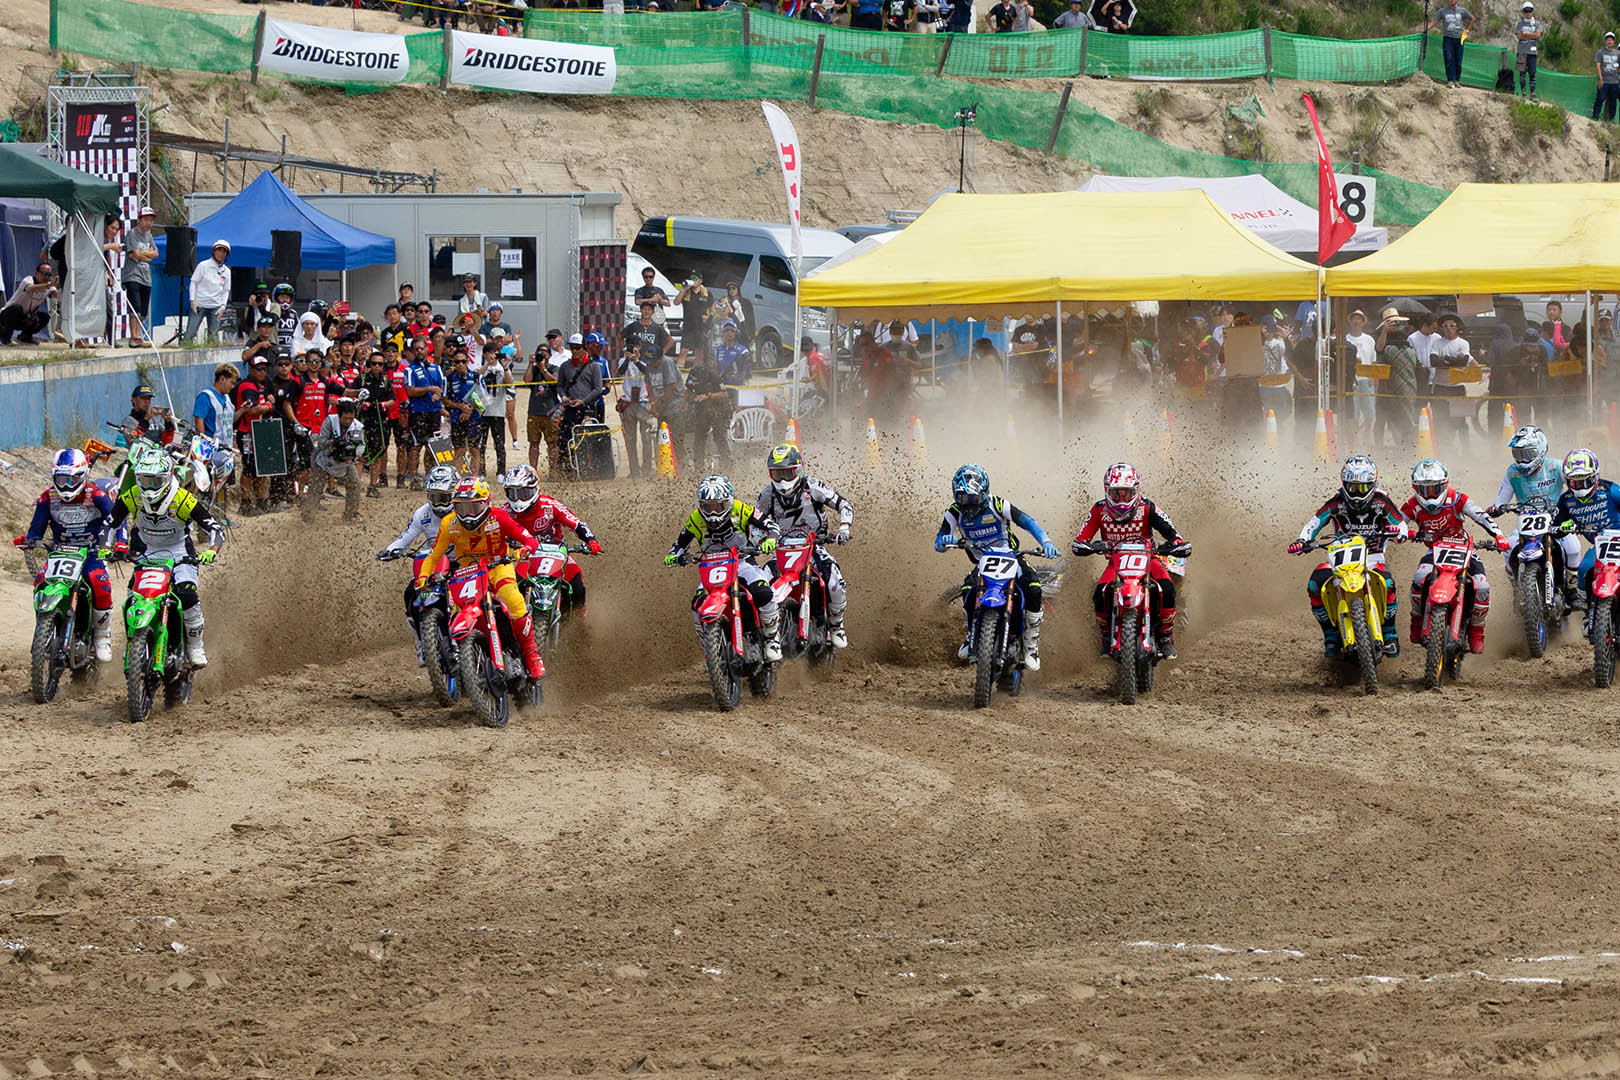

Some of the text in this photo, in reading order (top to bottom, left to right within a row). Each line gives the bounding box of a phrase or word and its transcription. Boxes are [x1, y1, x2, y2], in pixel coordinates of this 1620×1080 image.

[271, 38, 400, 69] BRIDGESTONE
[463, 48, 606, 76] BRIDGESTONE
[1340, 181, 1366, 223] 8
[661, 432, 668, 440] 6
[1536, 478, 1556, 488] THOR
[1522, 516, 1546, 531] 28
[1333, 547, 1362, 566] 11
[1436, 549, 1467, 565] 12
[1599, 541, 1620, 560] 15
[52, 560, 77, 577] 13
[537, 558, 555, 573] 8
[784, 551, 803, 569] 7
[983, 557, 1015, 574] 27
[1119, 554, 1148, 570] 10
[138, 572, 166, 589] 2
[708, 566, 728, 584] 6
[459, 580, 479, 599] 4
